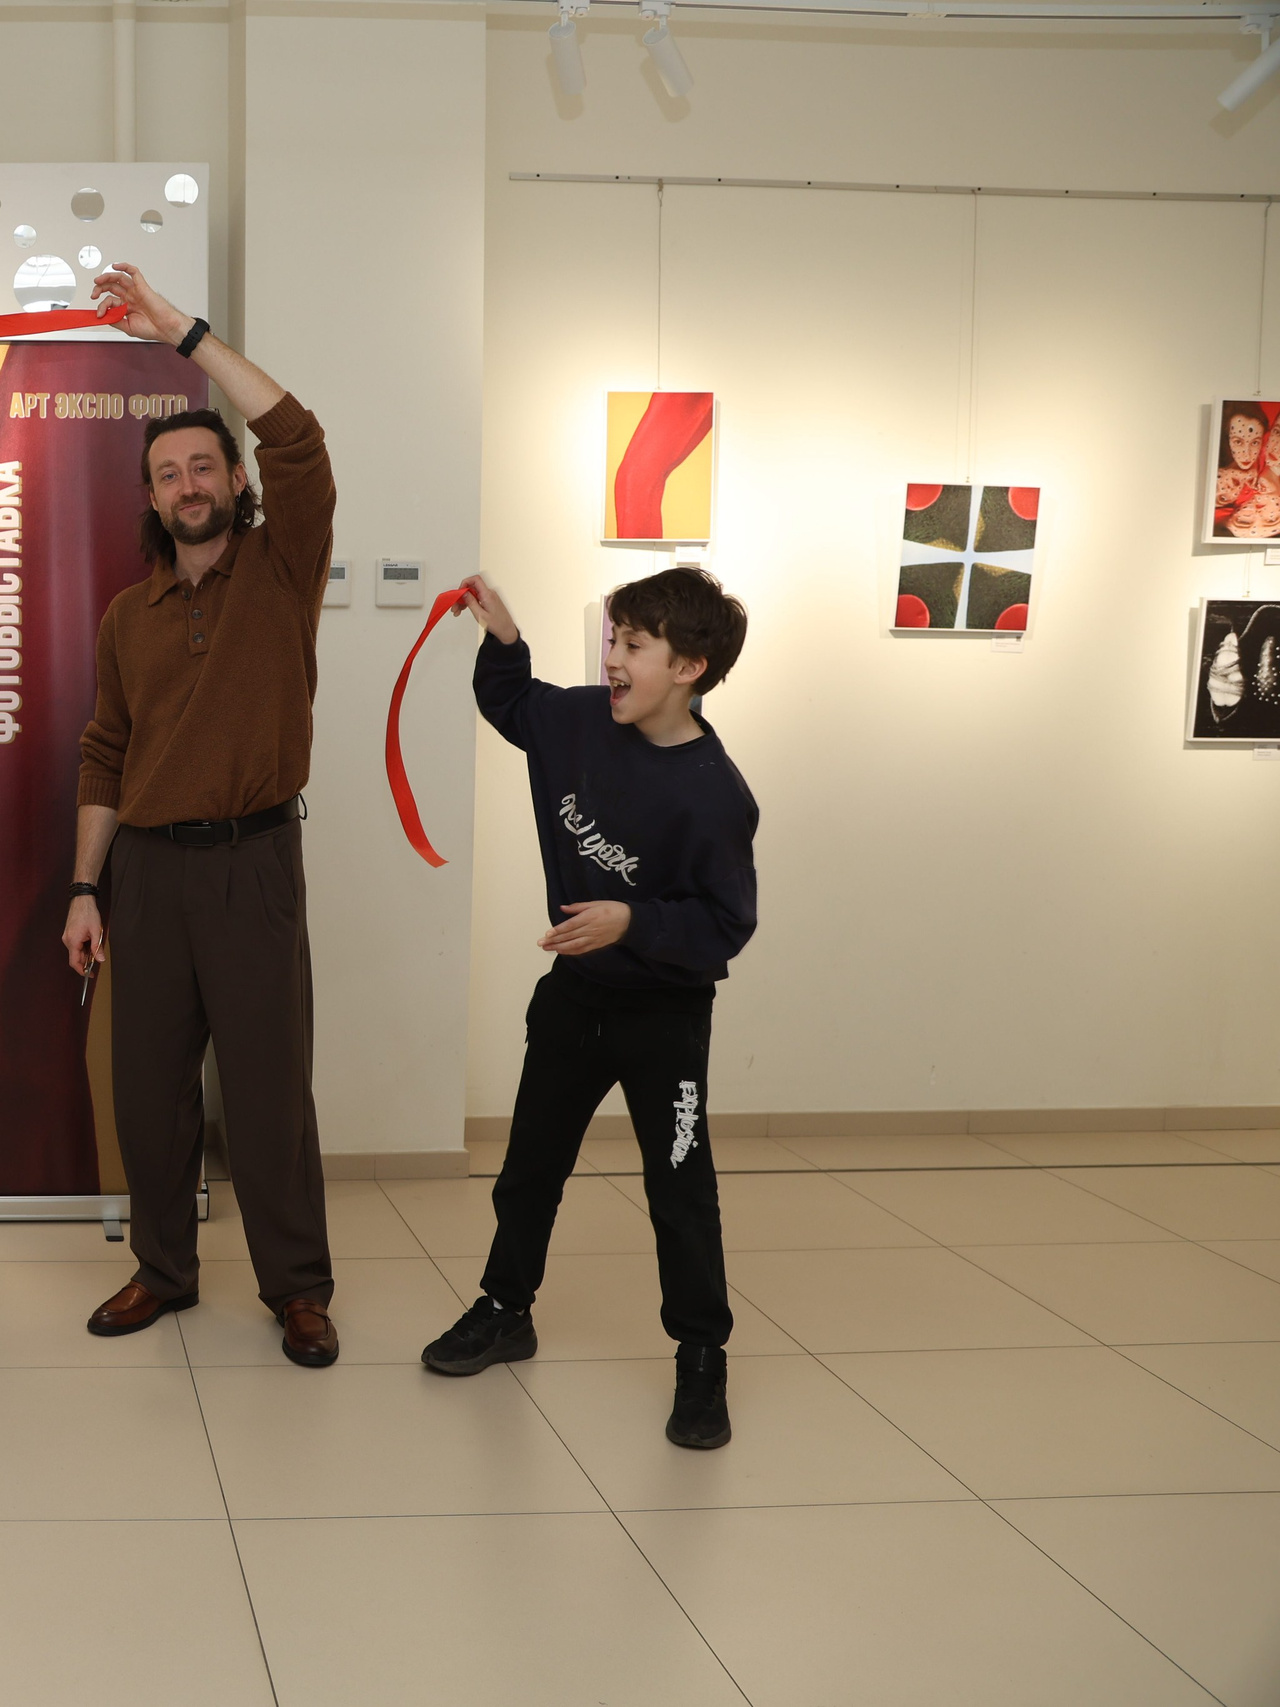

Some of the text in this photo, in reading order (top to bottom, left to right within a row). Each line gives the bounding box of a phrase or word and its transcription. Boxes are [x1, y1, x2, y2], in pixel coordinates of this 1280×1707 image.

[9, 392, 188, 420] АРТ ЭКСПО ФОТО
